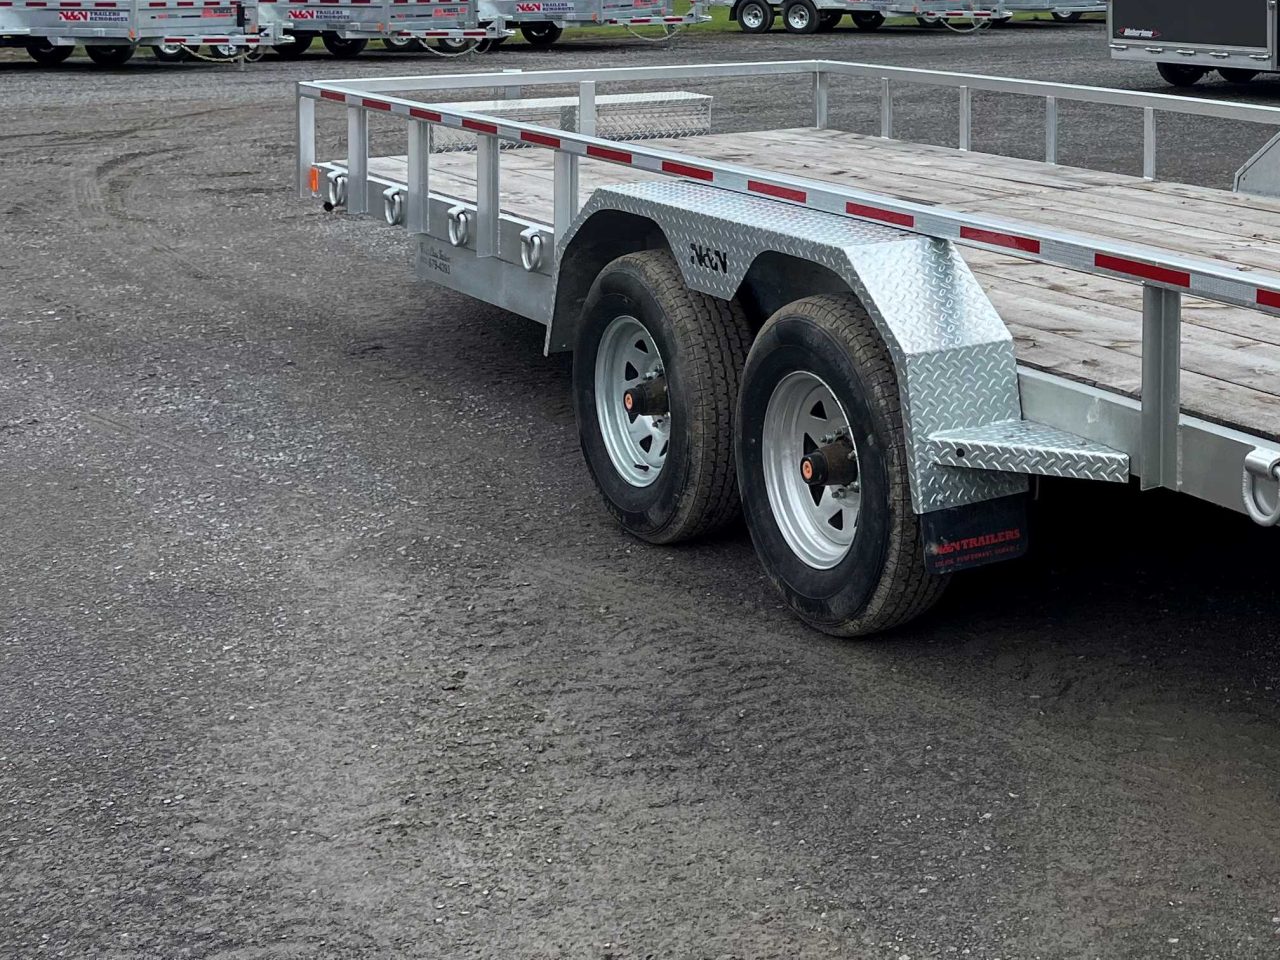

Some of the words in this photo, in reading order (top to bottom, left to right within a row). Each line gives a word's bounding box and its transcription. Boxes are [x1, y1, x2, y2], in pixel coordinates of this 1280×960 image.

[517, 3, 542, 12] N&N
[59, 11, 88, 21] N&N
[289, 10, 314, 19] N&N
[690, 243, 728, 273] N&N
